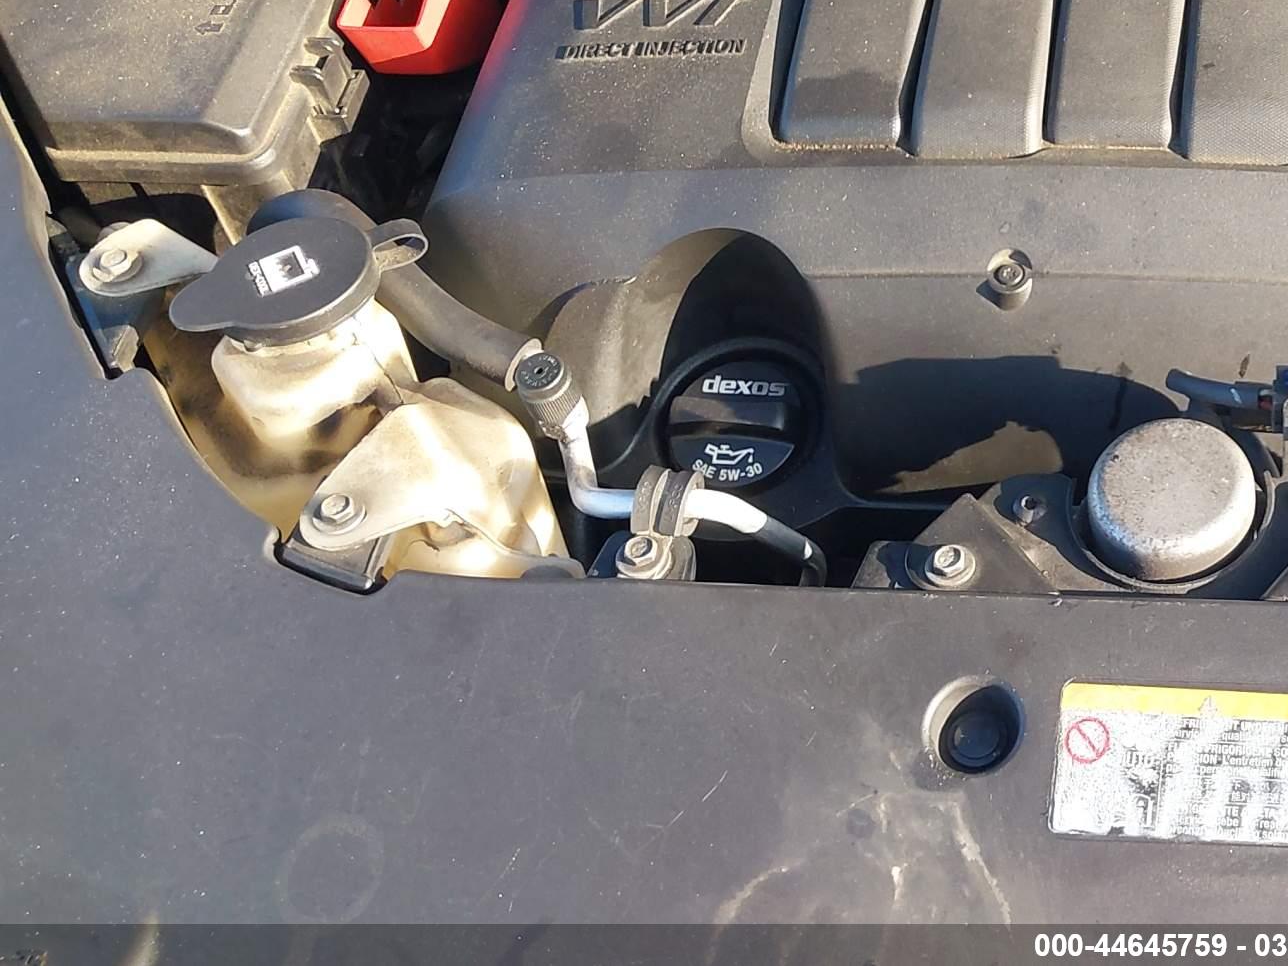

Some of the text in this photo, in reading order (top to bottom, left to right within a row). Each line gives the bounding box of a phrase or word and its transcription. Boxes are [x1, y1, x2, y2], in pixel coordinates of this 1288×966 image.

[555, 38, 748, 62] DIRECT INJECTION
[702, 375, 786, 397] dexos
[692, 459, 763, 482] SAE 5W-30
